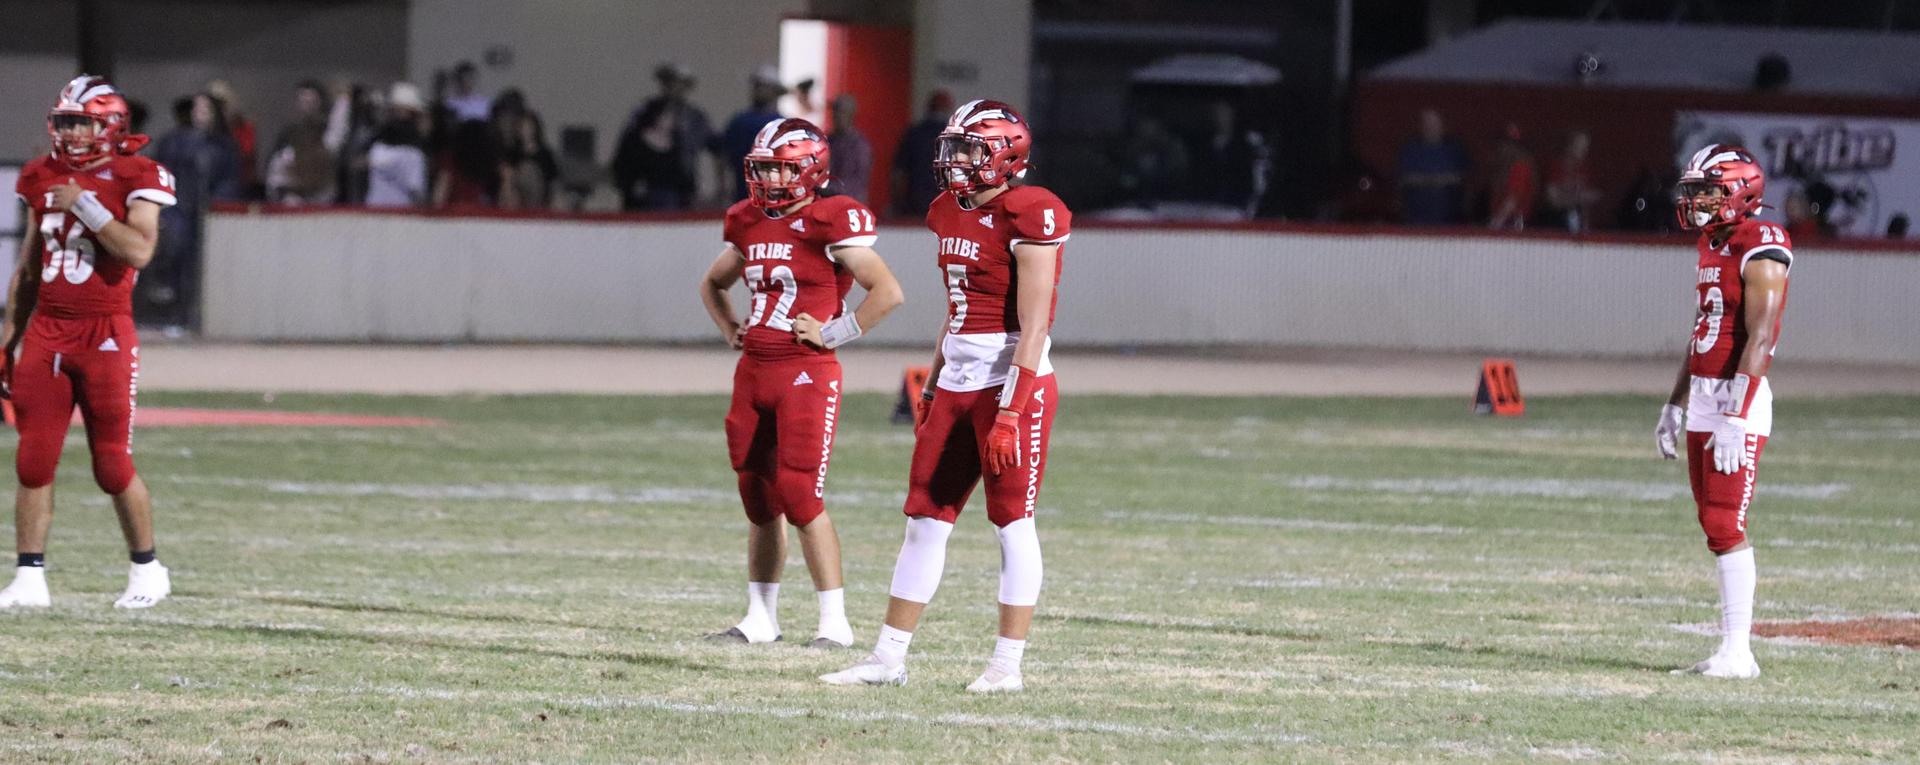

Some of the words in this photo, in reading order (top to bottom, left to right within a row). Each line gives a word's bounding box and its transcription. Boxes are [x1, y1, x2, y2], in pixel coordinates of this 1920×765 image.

[847, 208, 874, 233] 52
[1043, 208, 1056, 236] 5
[1760, 225, 1785, 243] 23
[40, 211, 96, 285] 56
[748, 242, 794, 262] TRIBE
[941, 236, 981, 261] TRIBE
[744, 264, 798, 332] 52
[946, 263, 969, 334] 5
[814, 379, 839, 499] CHOWCHILLA
[1024, 387, 1045, 519] CHOWCHILLA
